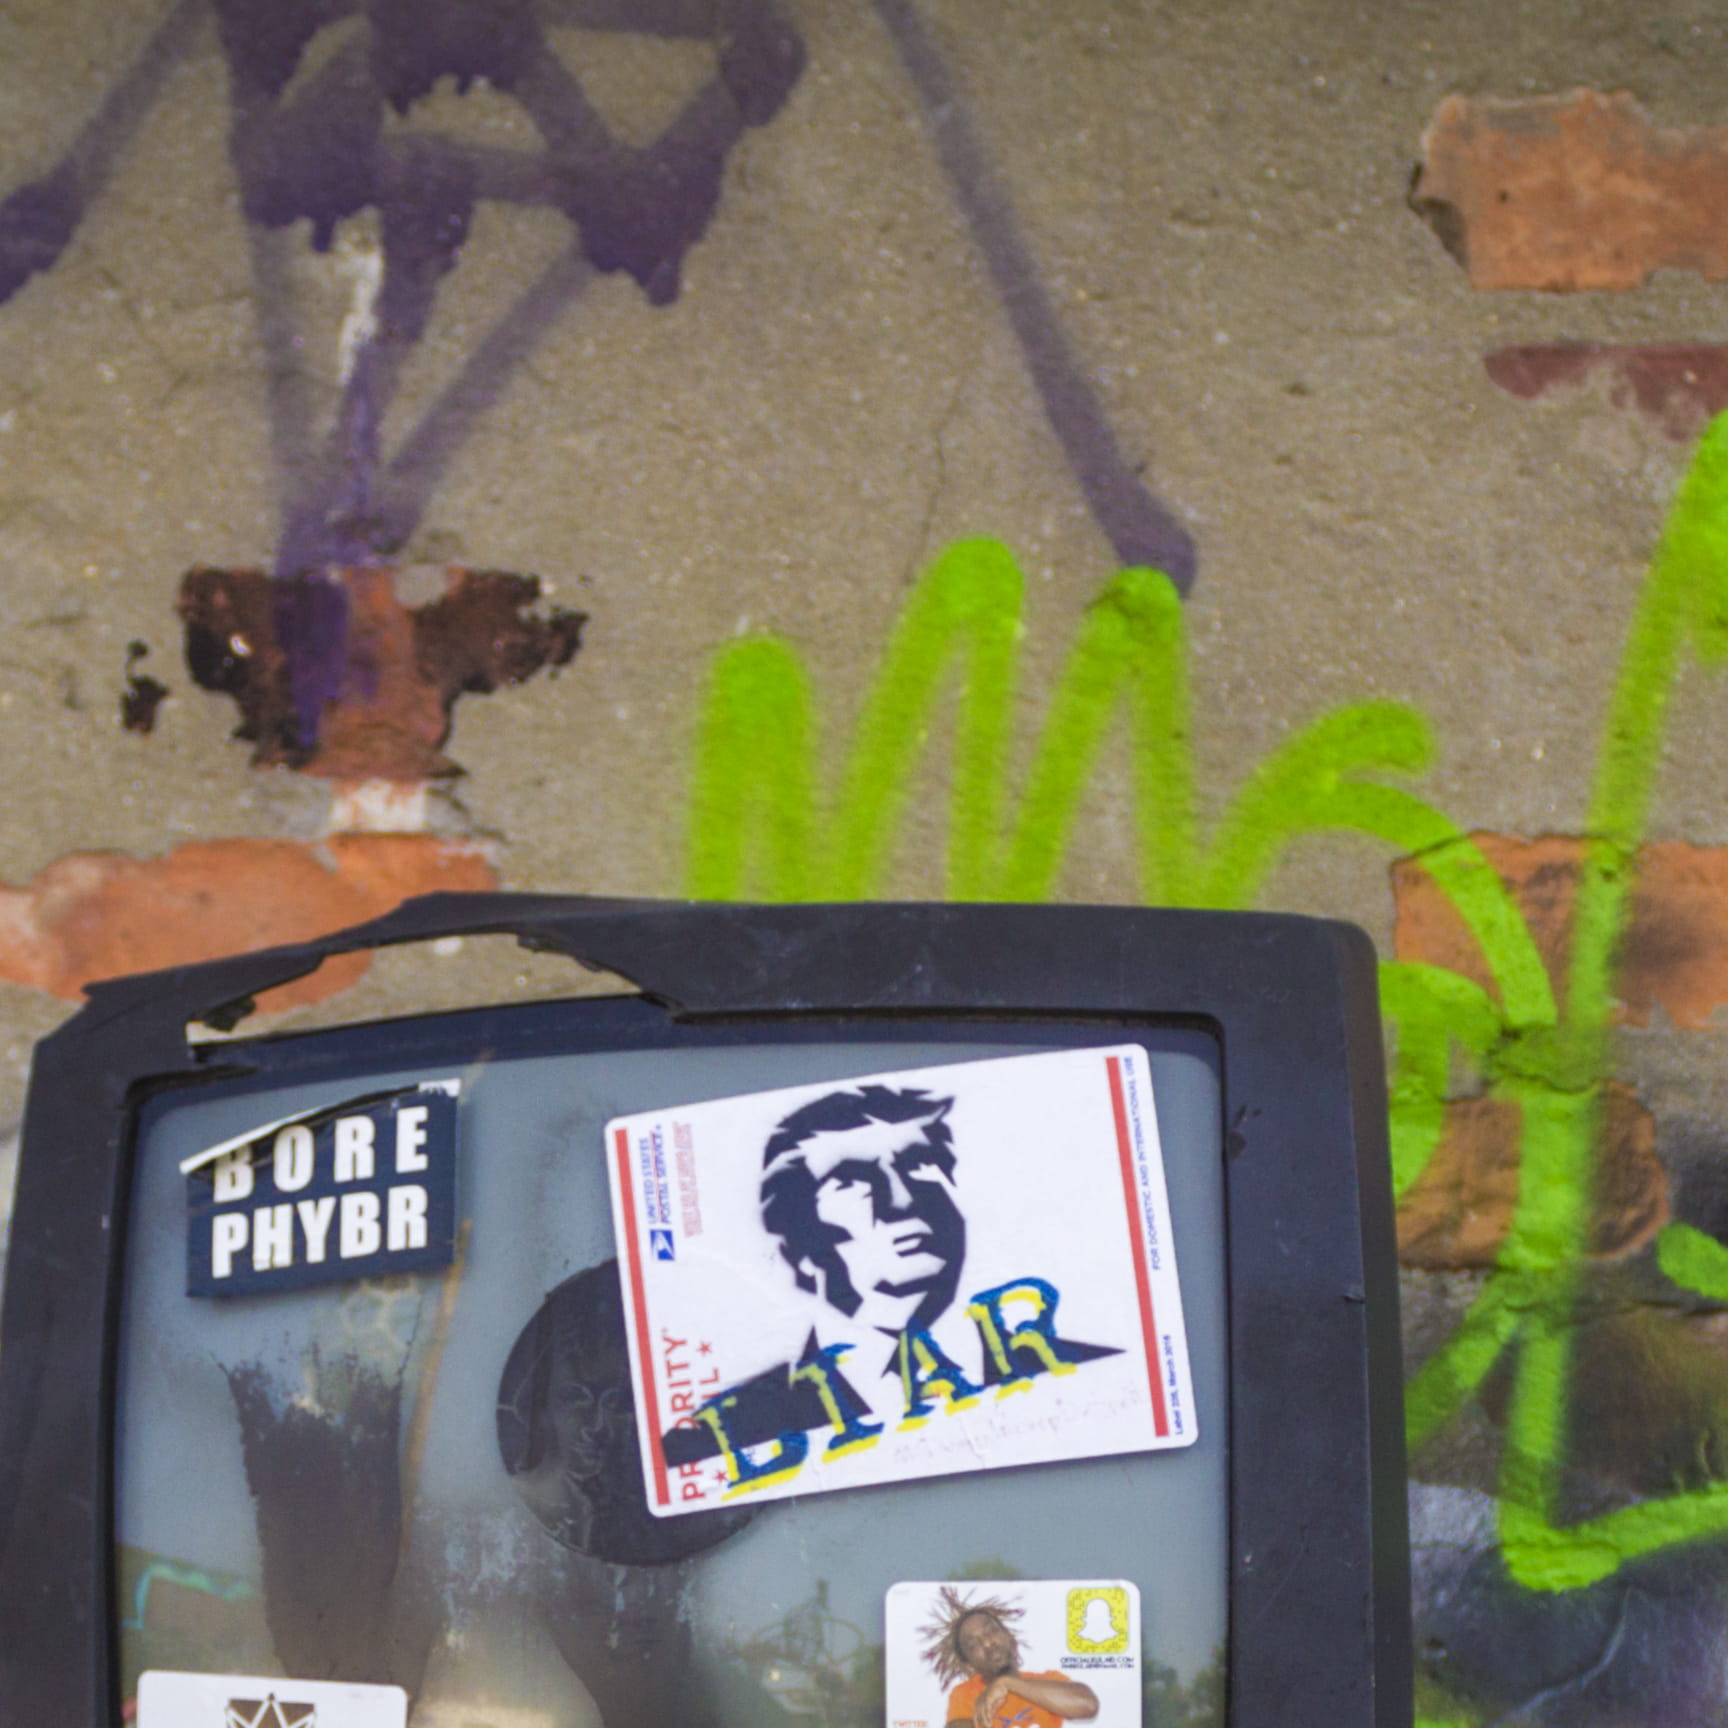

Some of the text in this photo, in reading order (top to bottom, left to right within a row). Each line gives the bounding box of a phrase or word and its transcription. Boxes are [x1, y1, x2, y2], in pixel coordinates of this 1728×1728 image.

[212, 1106, 429, 1204] BORE
[1128, 1079, 1147, 1162] INTERNATIONAL
[1138, 1164, 1149, 1187] AND
[212, 1185, 428, 1279] PHYBR
[1142, 1190, 1158, 1246] DOMESTIC
[1149, 1247, 1161, 1271] FOR
[691, 1276, 1077, 1501] LIAR
